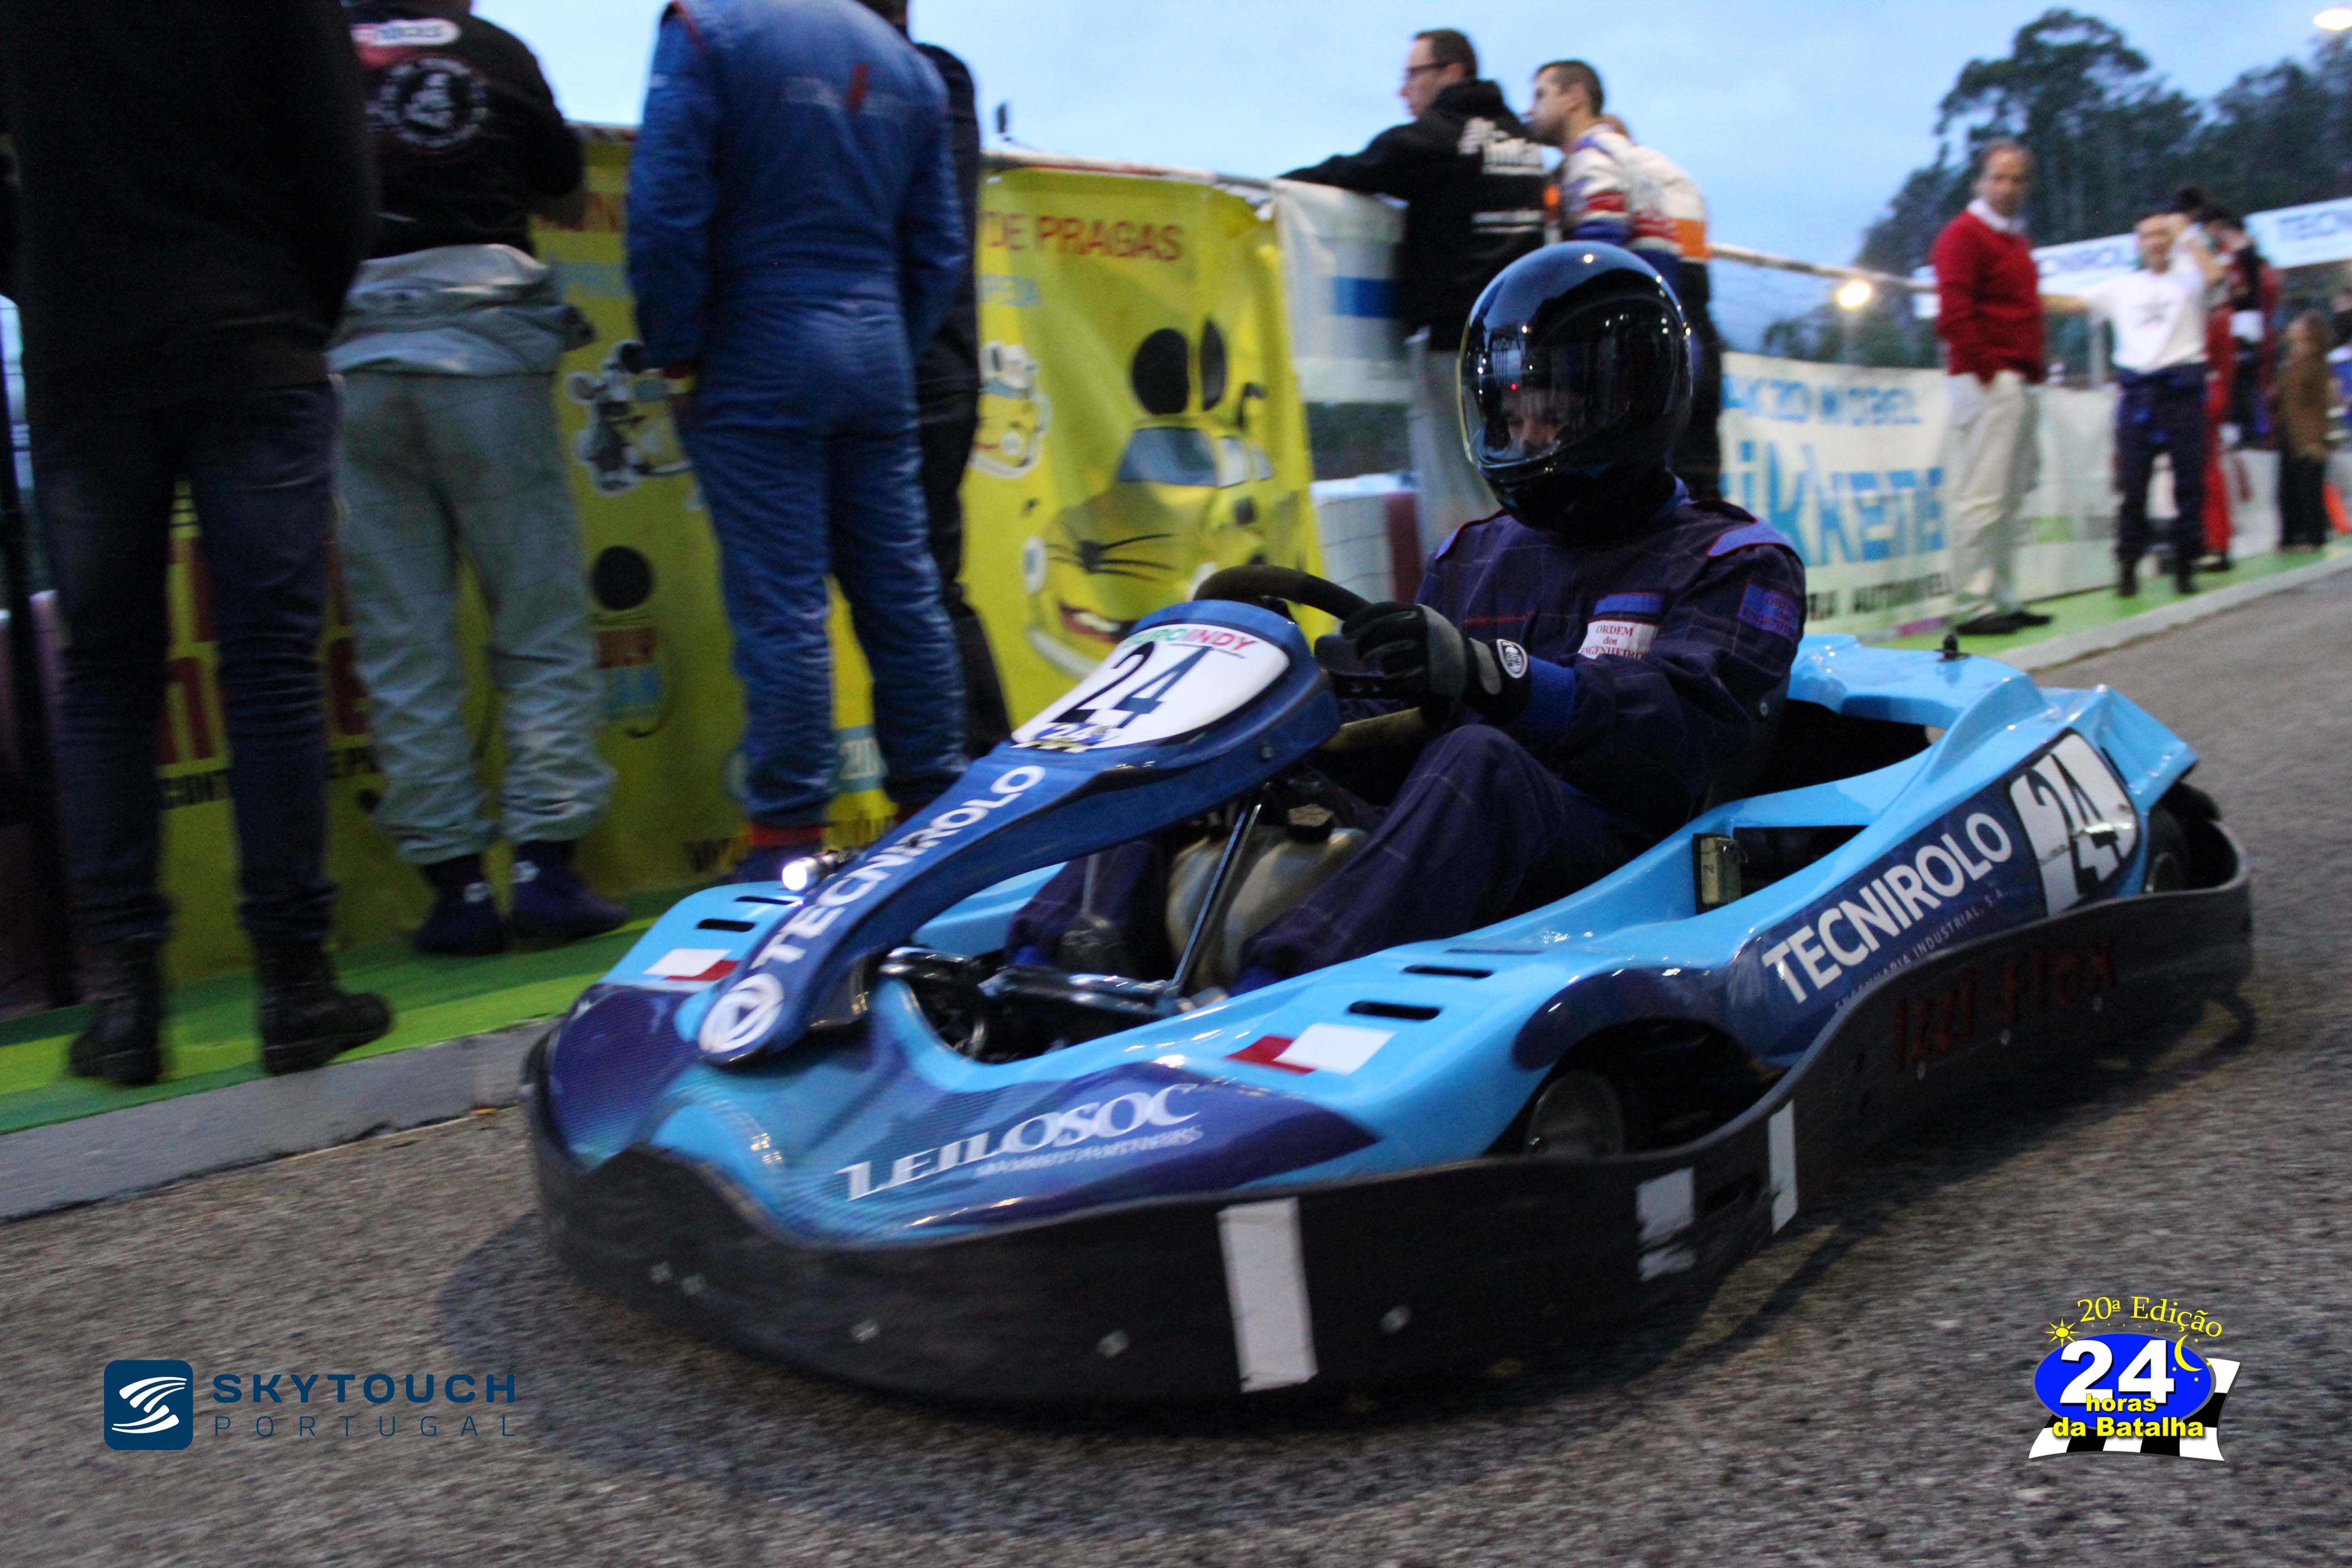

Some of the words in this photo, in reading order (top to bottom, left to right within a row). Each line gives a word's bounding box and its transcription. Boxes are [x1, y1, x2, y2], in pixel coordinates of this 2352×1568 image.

[1035, 215, 1183, 262] PRAGAS
[1596, 625, 1633, 636] ORDEM
[1603, 636, 1617, 645] dos
[1049, 640, 1217, 729] 24
[750, 765, 1046, 970] TECNIROLO
[2024, 753, 2124, 895] 24
[1762, 813, 2013, 1004] TECNIROLO
[836, 1083, 1200, 1202] LEILOSOC
